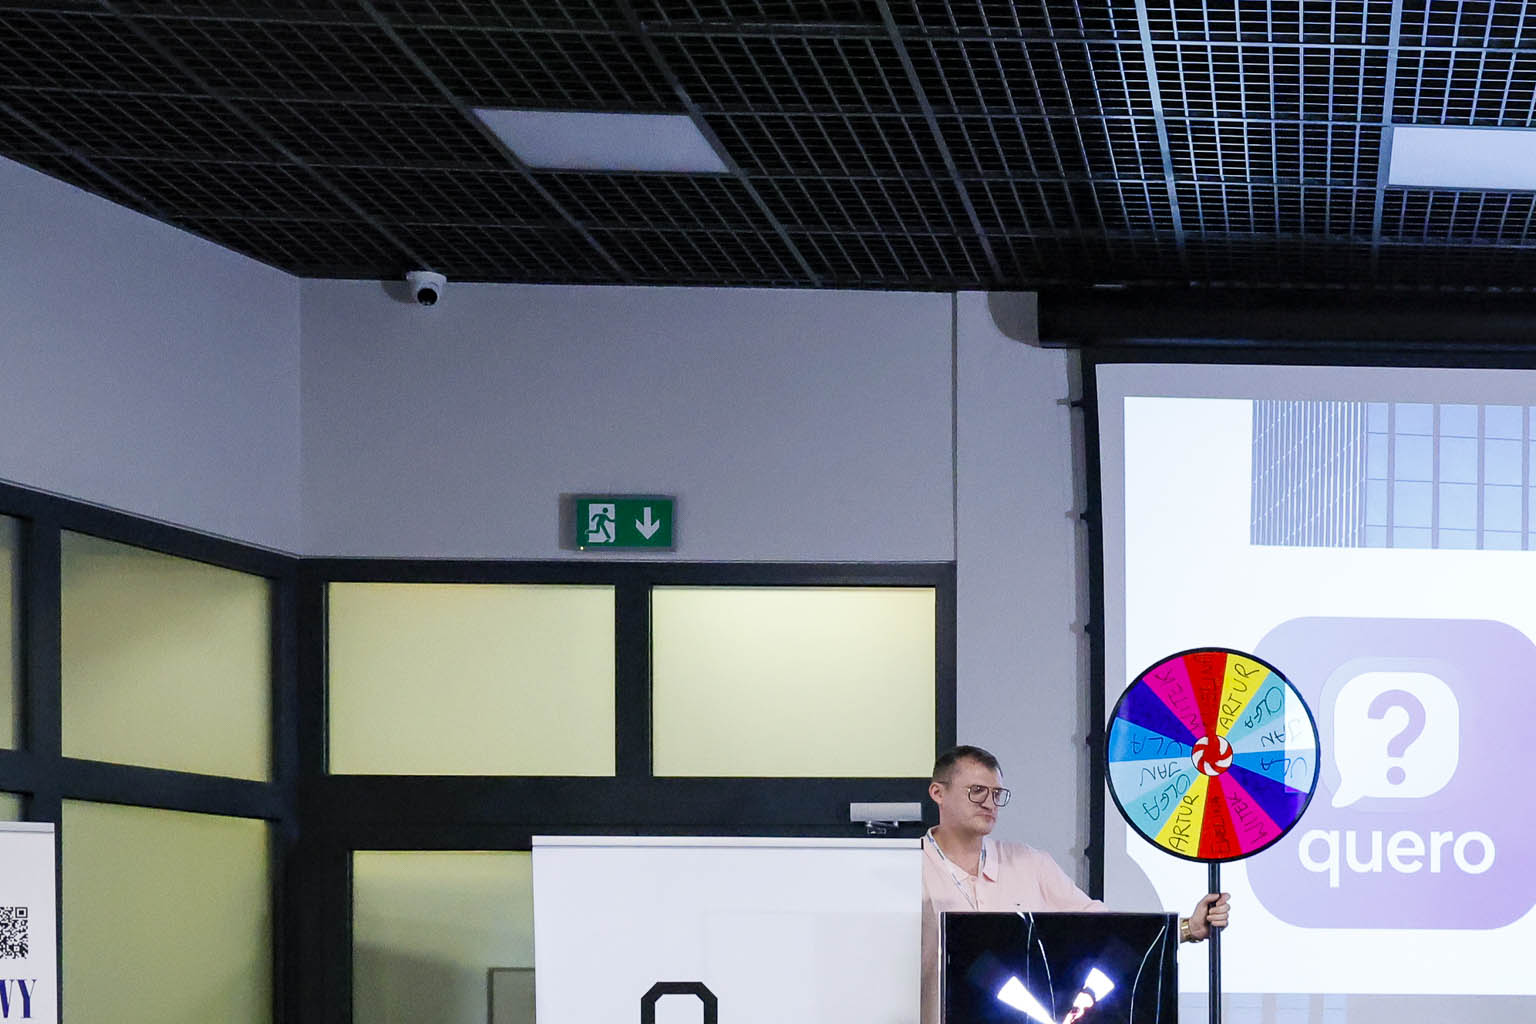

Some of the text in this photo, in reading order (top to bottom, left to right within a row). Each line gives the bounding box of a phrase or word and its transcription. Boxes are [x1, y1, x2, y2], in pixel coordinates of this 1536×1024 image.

[1219, 663, 1261, 730] ARTUR
[1244, 686, 1284, 729] OLGA
[1130, 736, 1183, 755] ULA
[1139, 761, 1182, 787] JAN
[1142, 773, 1191, 821] OLGA
[1168, 793, 1200, 852] ARTUR
[1227, 791, 1269, 843] WITEK
[1298, 825, 1496, 887] quero
